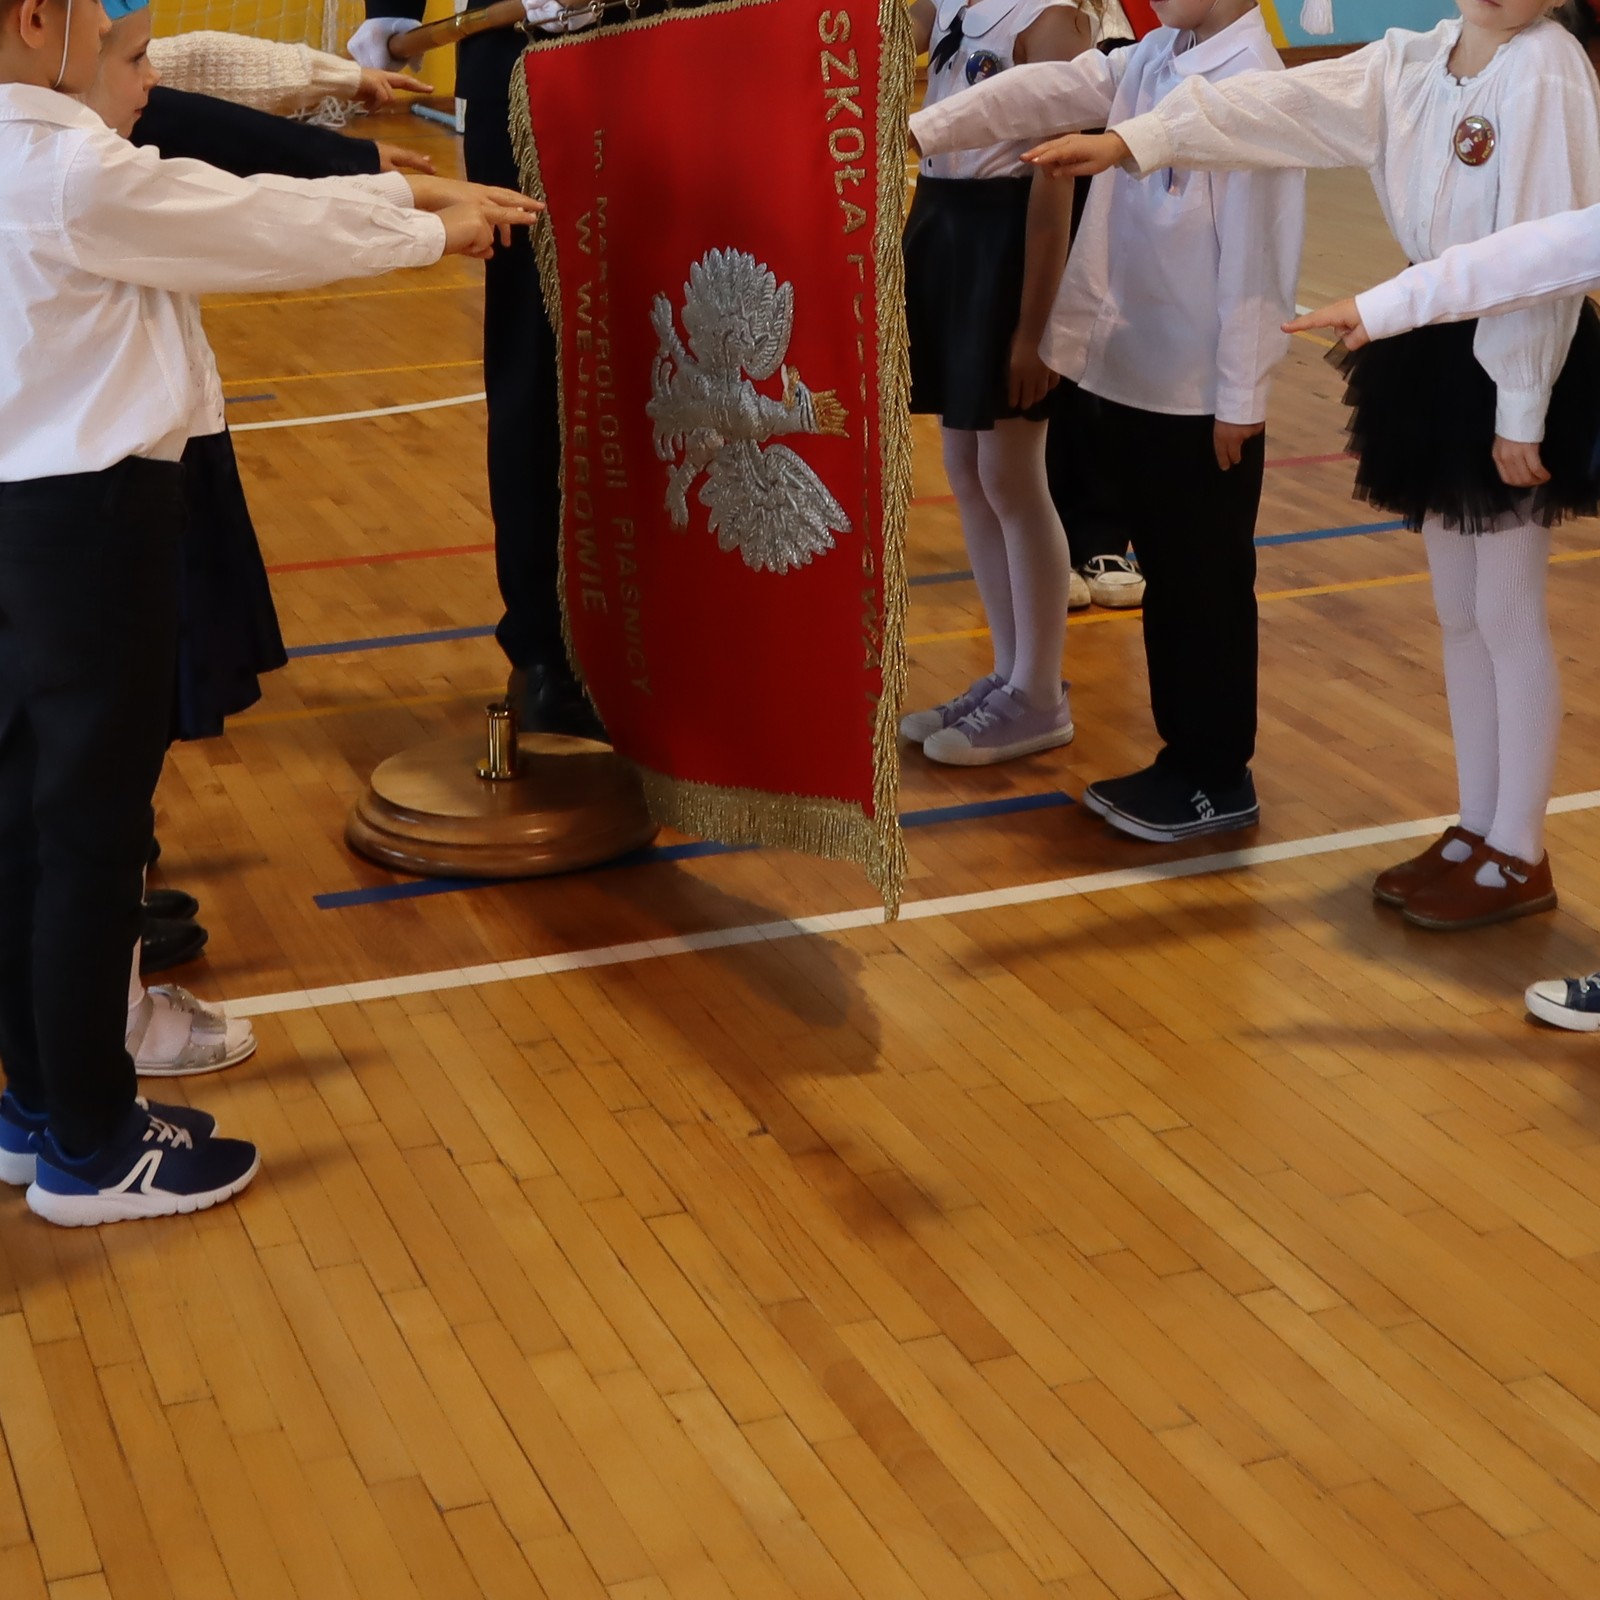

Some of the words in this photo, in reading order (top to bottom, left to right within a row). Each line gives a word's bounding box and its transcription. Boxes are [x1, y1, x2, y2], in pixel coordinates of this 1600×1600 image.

[575, 211, 592, 255] W
[818, 9, 867, 236] SZKOŁA
[572, 280, 608, 616] WEJHEROWIE
[596, 196, 629, 489] MARTYROLOGII
